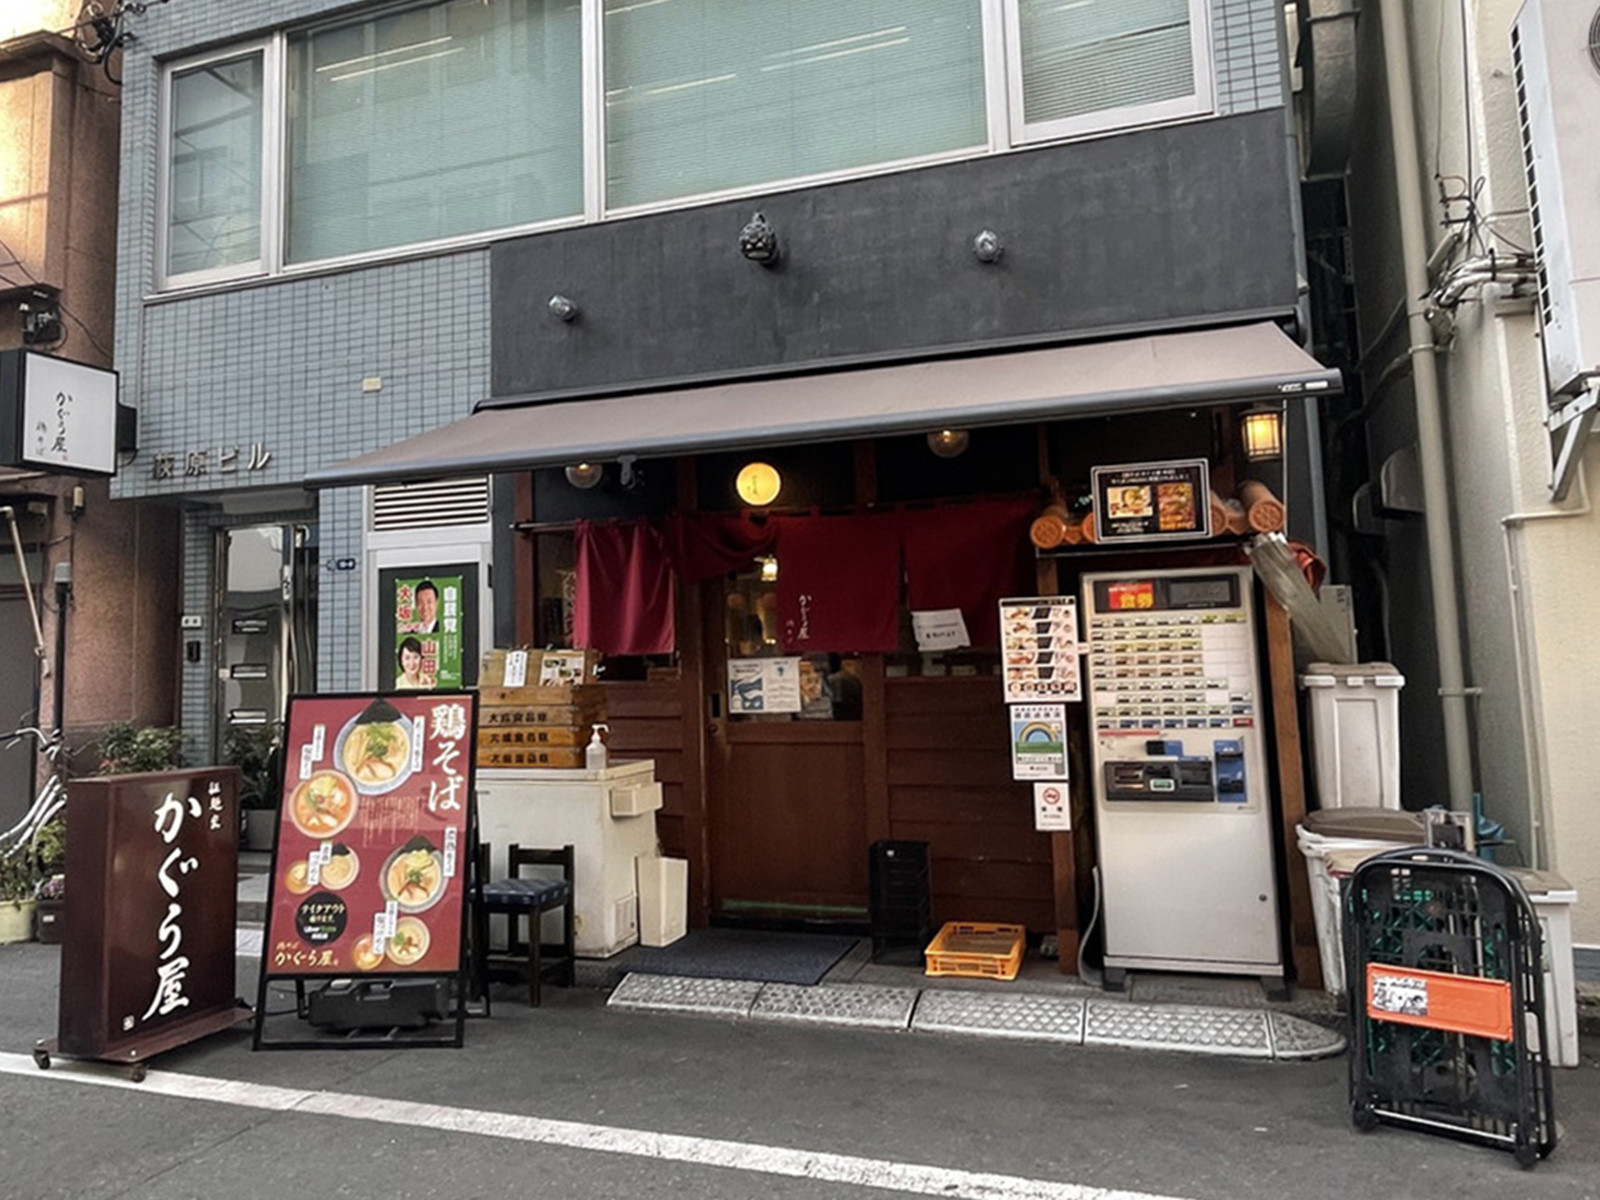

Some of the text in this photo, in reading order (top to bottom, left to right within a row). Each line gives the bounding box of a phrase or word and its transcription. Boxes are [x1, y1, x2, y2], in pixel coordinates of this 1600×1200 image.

[429, 703, 467, 812] 鶏そば
[142, 792, 202, 1021] かぐら屋
[274, 951, 334, 967] かぐら屋
